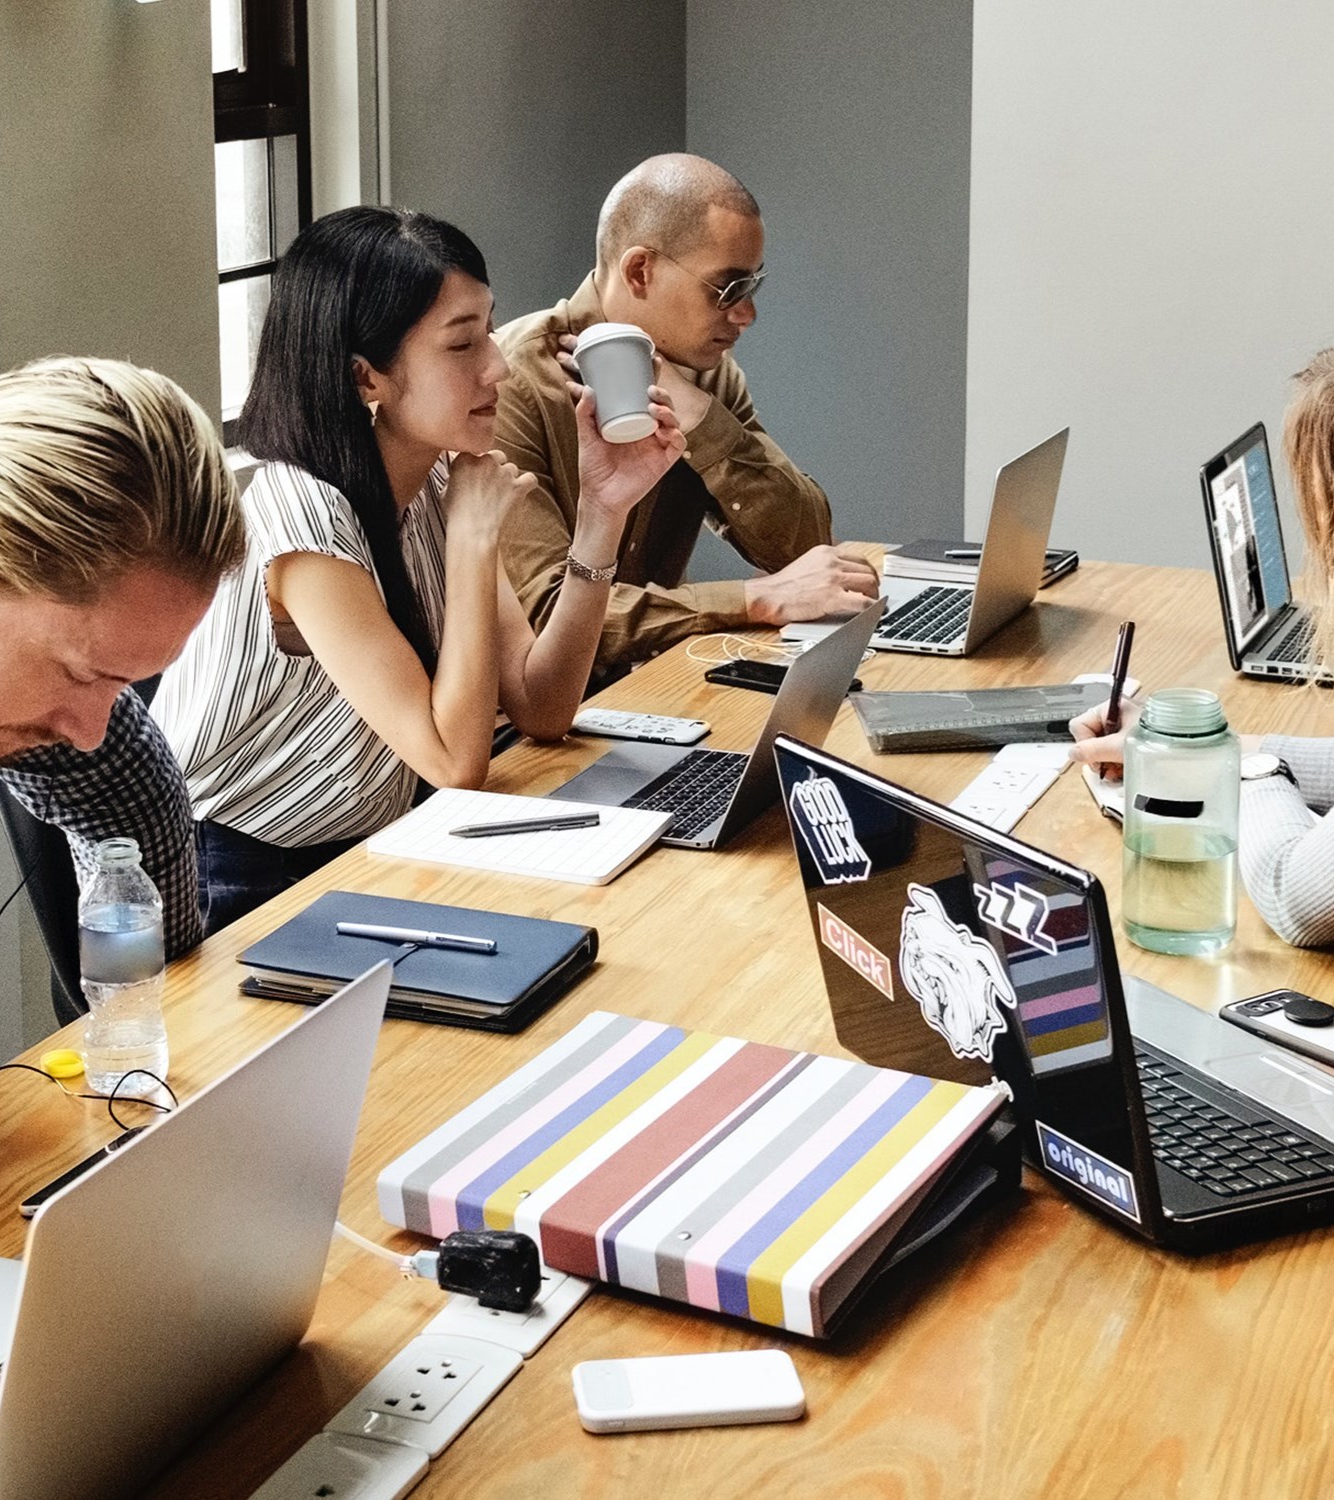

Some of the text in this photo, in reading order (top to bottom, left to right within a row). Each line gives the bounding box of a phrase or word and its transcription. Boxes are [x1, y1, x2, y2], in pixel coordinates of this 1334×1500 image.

[794, 782, 851, 827] GOOD
[811, 821, 869, 866] LUCK
[825, 917, 886, 988] Click
[1047, 1142, 1129, 1203] original
